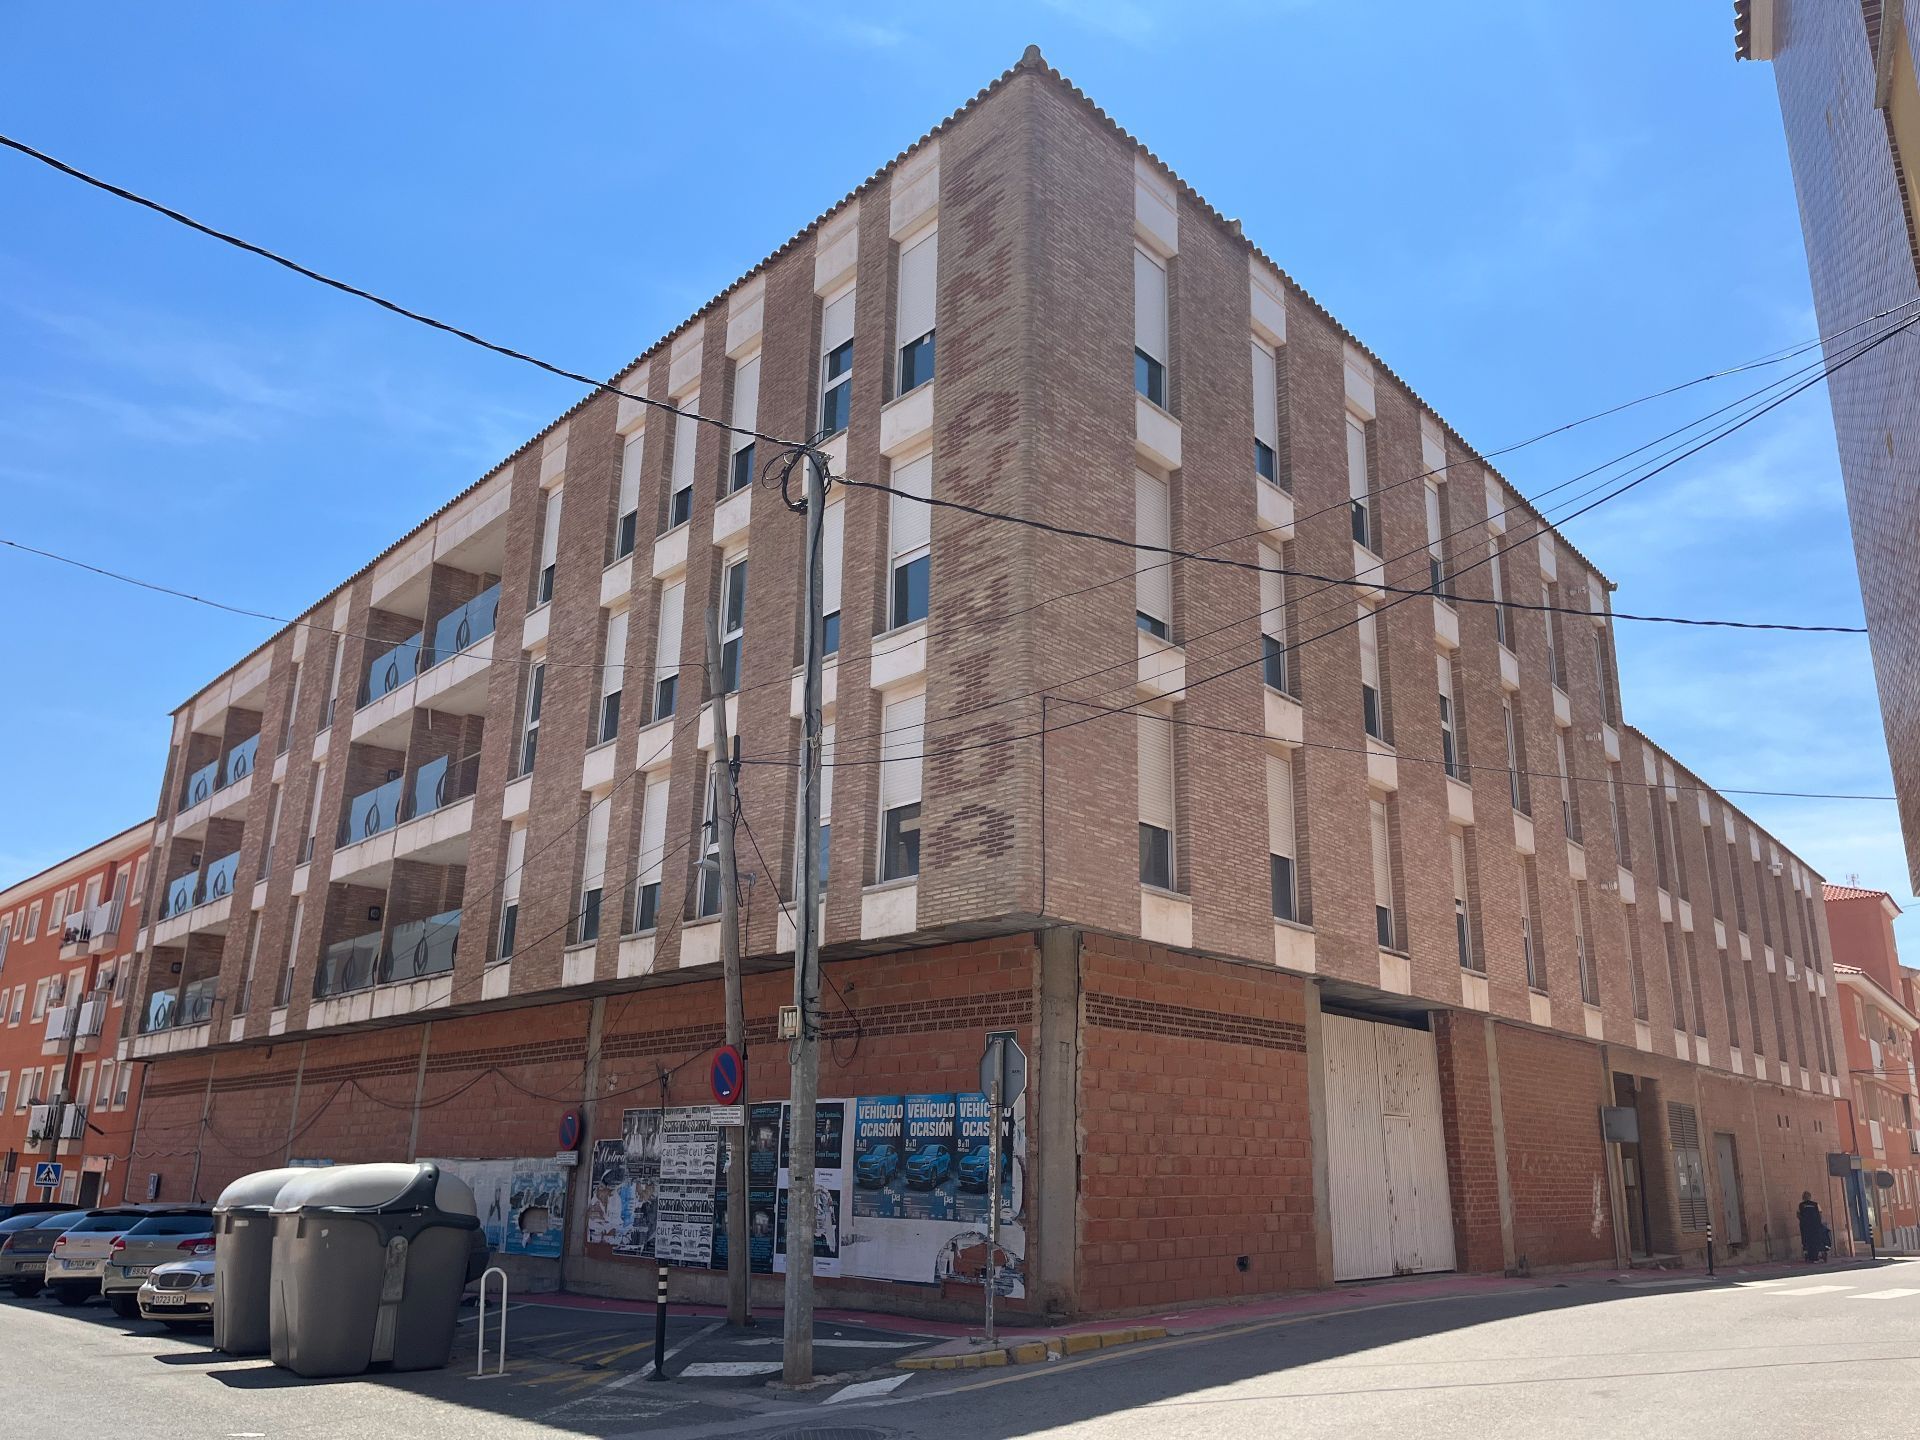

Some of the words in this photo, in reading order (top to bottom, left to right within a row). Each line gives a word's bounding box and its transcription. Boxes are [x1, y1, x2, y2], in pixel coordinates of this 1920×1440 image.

[859, 1102, 903, 1119] VEHÍCULO
[908, 1099, 955, 1118] VEHÍCULO
[860, 1119, 901, 1137] OCASIÓN
[910, 1118, 953, 1137] OCASIÓN
[962, 1121, 1009, 1137] OCASN
[156, 1296, 171, 1304] 0723
